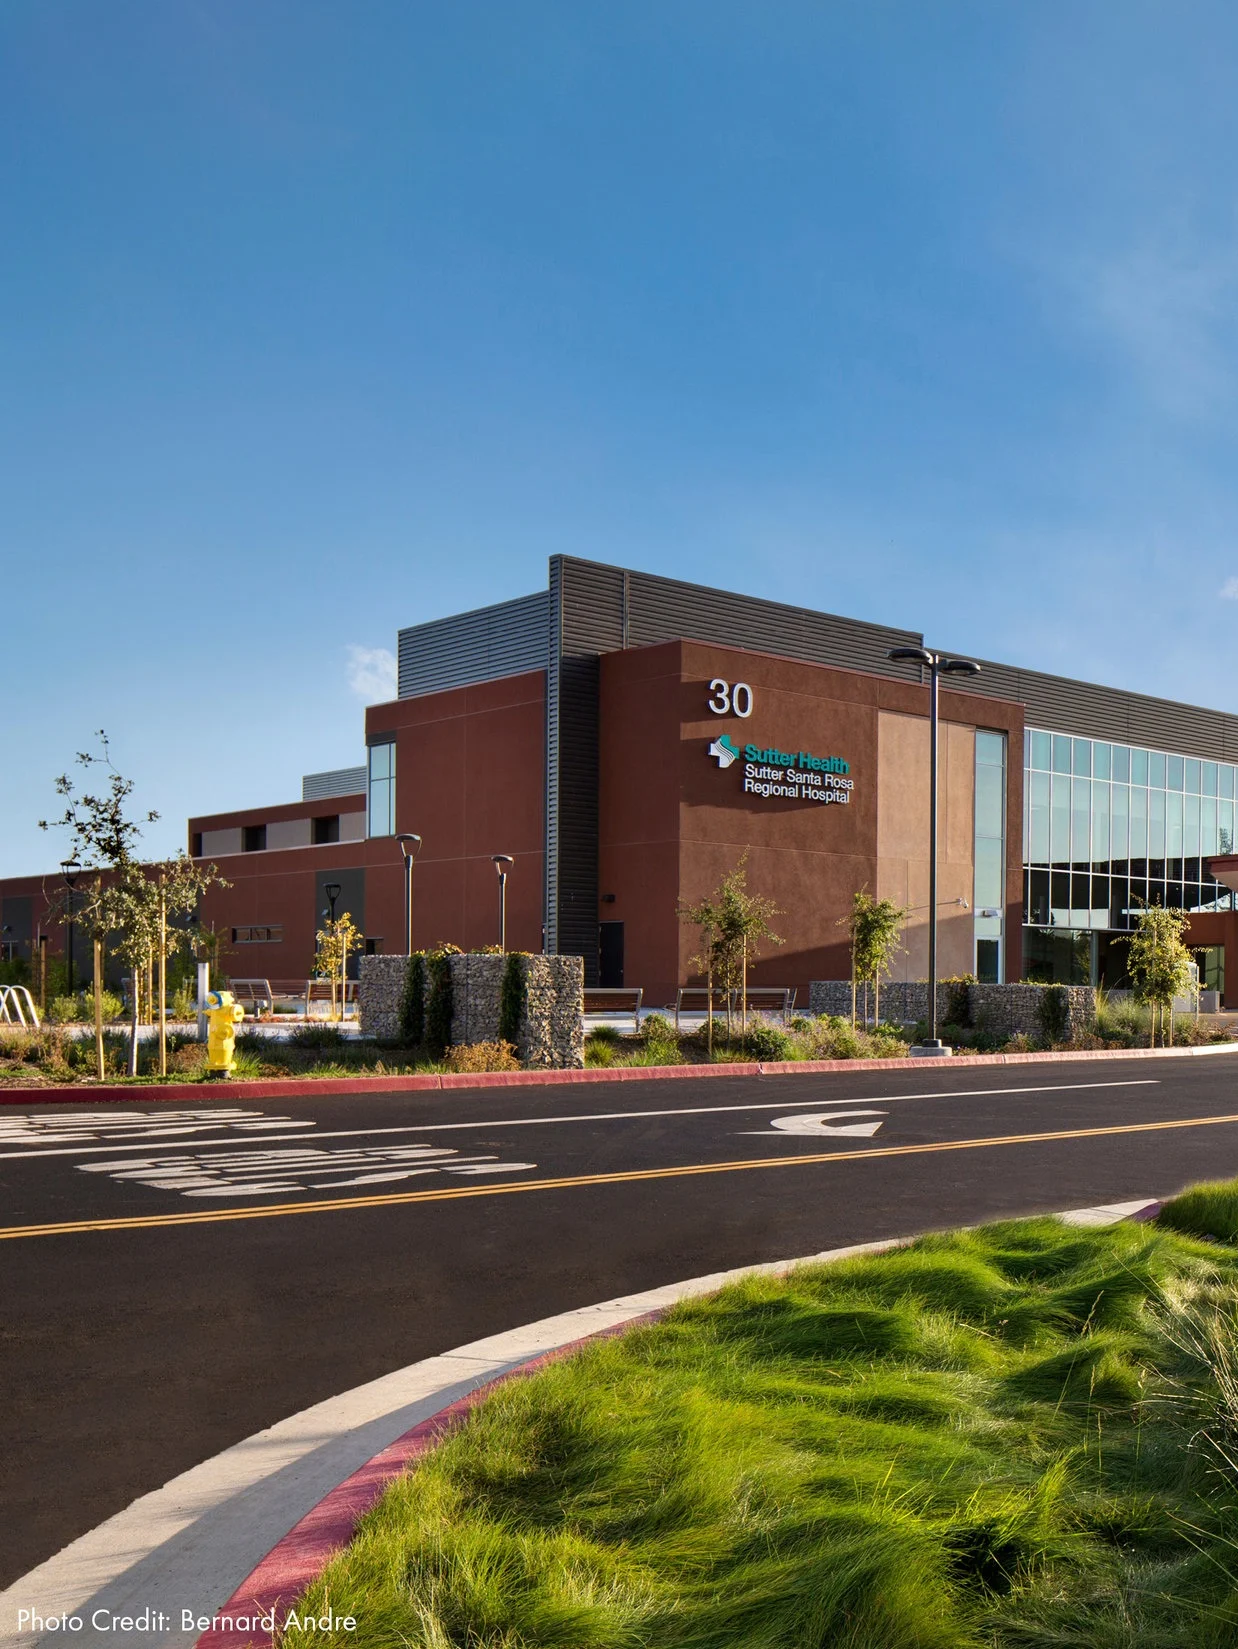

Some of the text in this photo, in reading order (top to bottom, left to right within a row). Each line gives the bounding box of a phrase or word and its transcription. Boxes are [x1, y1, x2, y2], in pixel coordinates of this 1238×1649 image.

[708, 678, 753, 718] 30
[744, 743, 850, 775] Sutter Health
[743, 778, 850, 804] Regional Hospital
[744, 763, 854, 790] Sutter Santa Rosa
